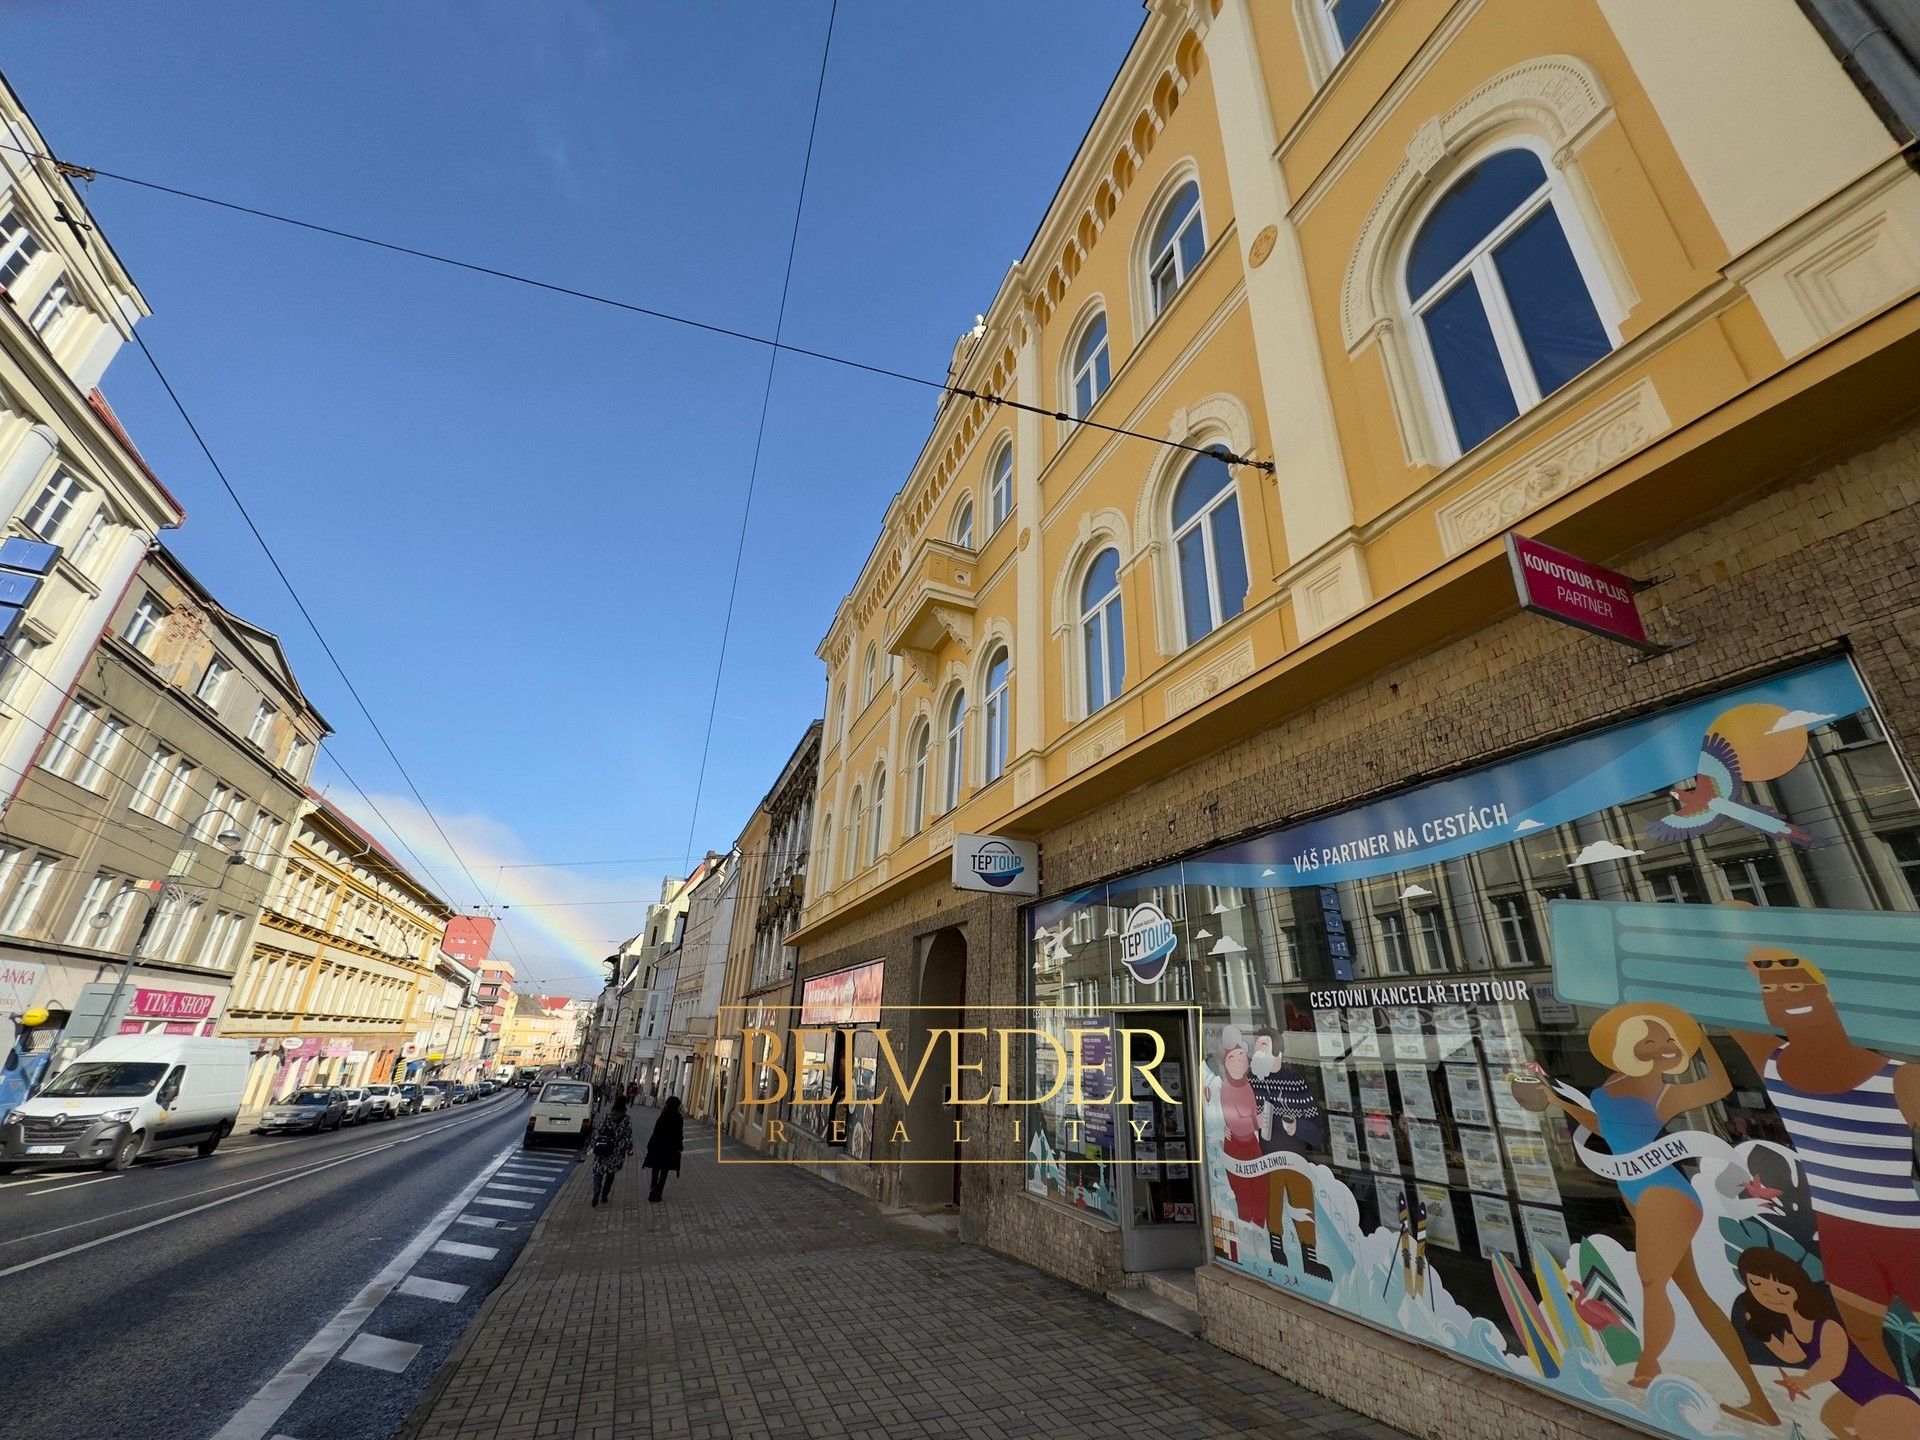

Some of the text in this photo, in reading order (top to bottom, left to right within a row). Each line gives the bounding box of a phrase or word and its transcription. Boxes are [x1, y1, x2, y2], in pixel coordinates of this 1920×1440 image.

[1523, 551, 1630, 604] KOVOTOUR PLUS
[1557, 585, 1613, 619] PARTNER
[1293, 802, 1509, 874] VÁŠ PARTNER NA CESTÁCH
[970, 854, 1022, 871] TEPTOUR
[1121, 921, 1171, 959] TEPTOUR
[144, 992, 211, 1015] TINA SHOP
[1310, 985, 1368, 1008] CESTOVNÍ
[1371, 980, 1448, 1006] KANCELÁŘ
[1450, 979, 1530, 1002] TEPTOUR
[1259, 1160, 1268, 1171] ZA
[1622, 1161, 1643, 1177] ZA
[1637, 1139, 1689, 1170] TEPLEM
